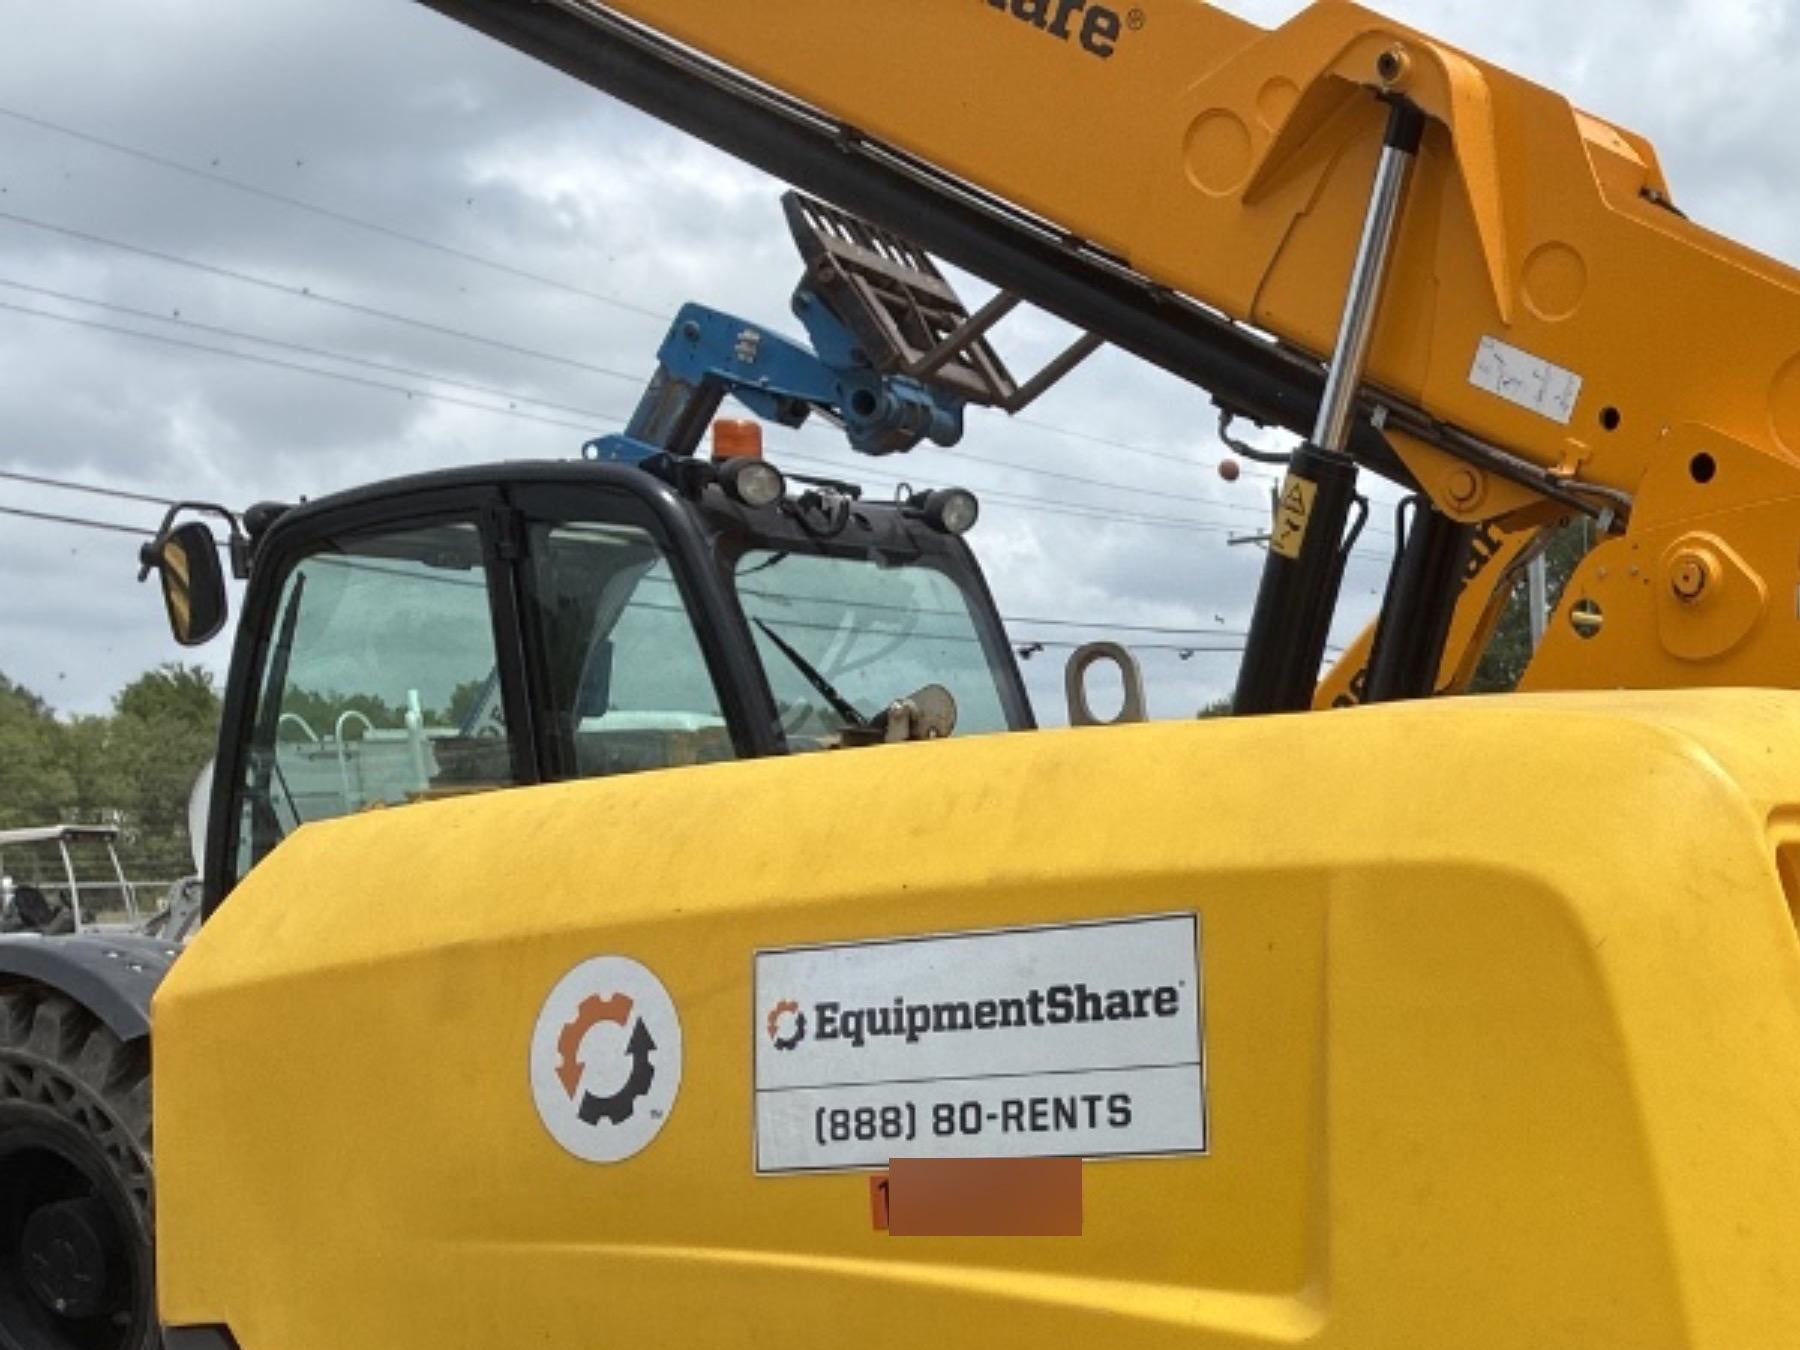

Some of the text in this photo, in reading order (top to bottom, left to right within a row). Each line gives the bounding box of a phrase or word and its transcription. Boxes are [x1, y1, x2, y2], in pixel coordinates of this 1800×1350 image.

[813, 982, 1181, 1046] EquipmentShare
[814, 1093, 1134, 1146] (888) 80-RENTS
